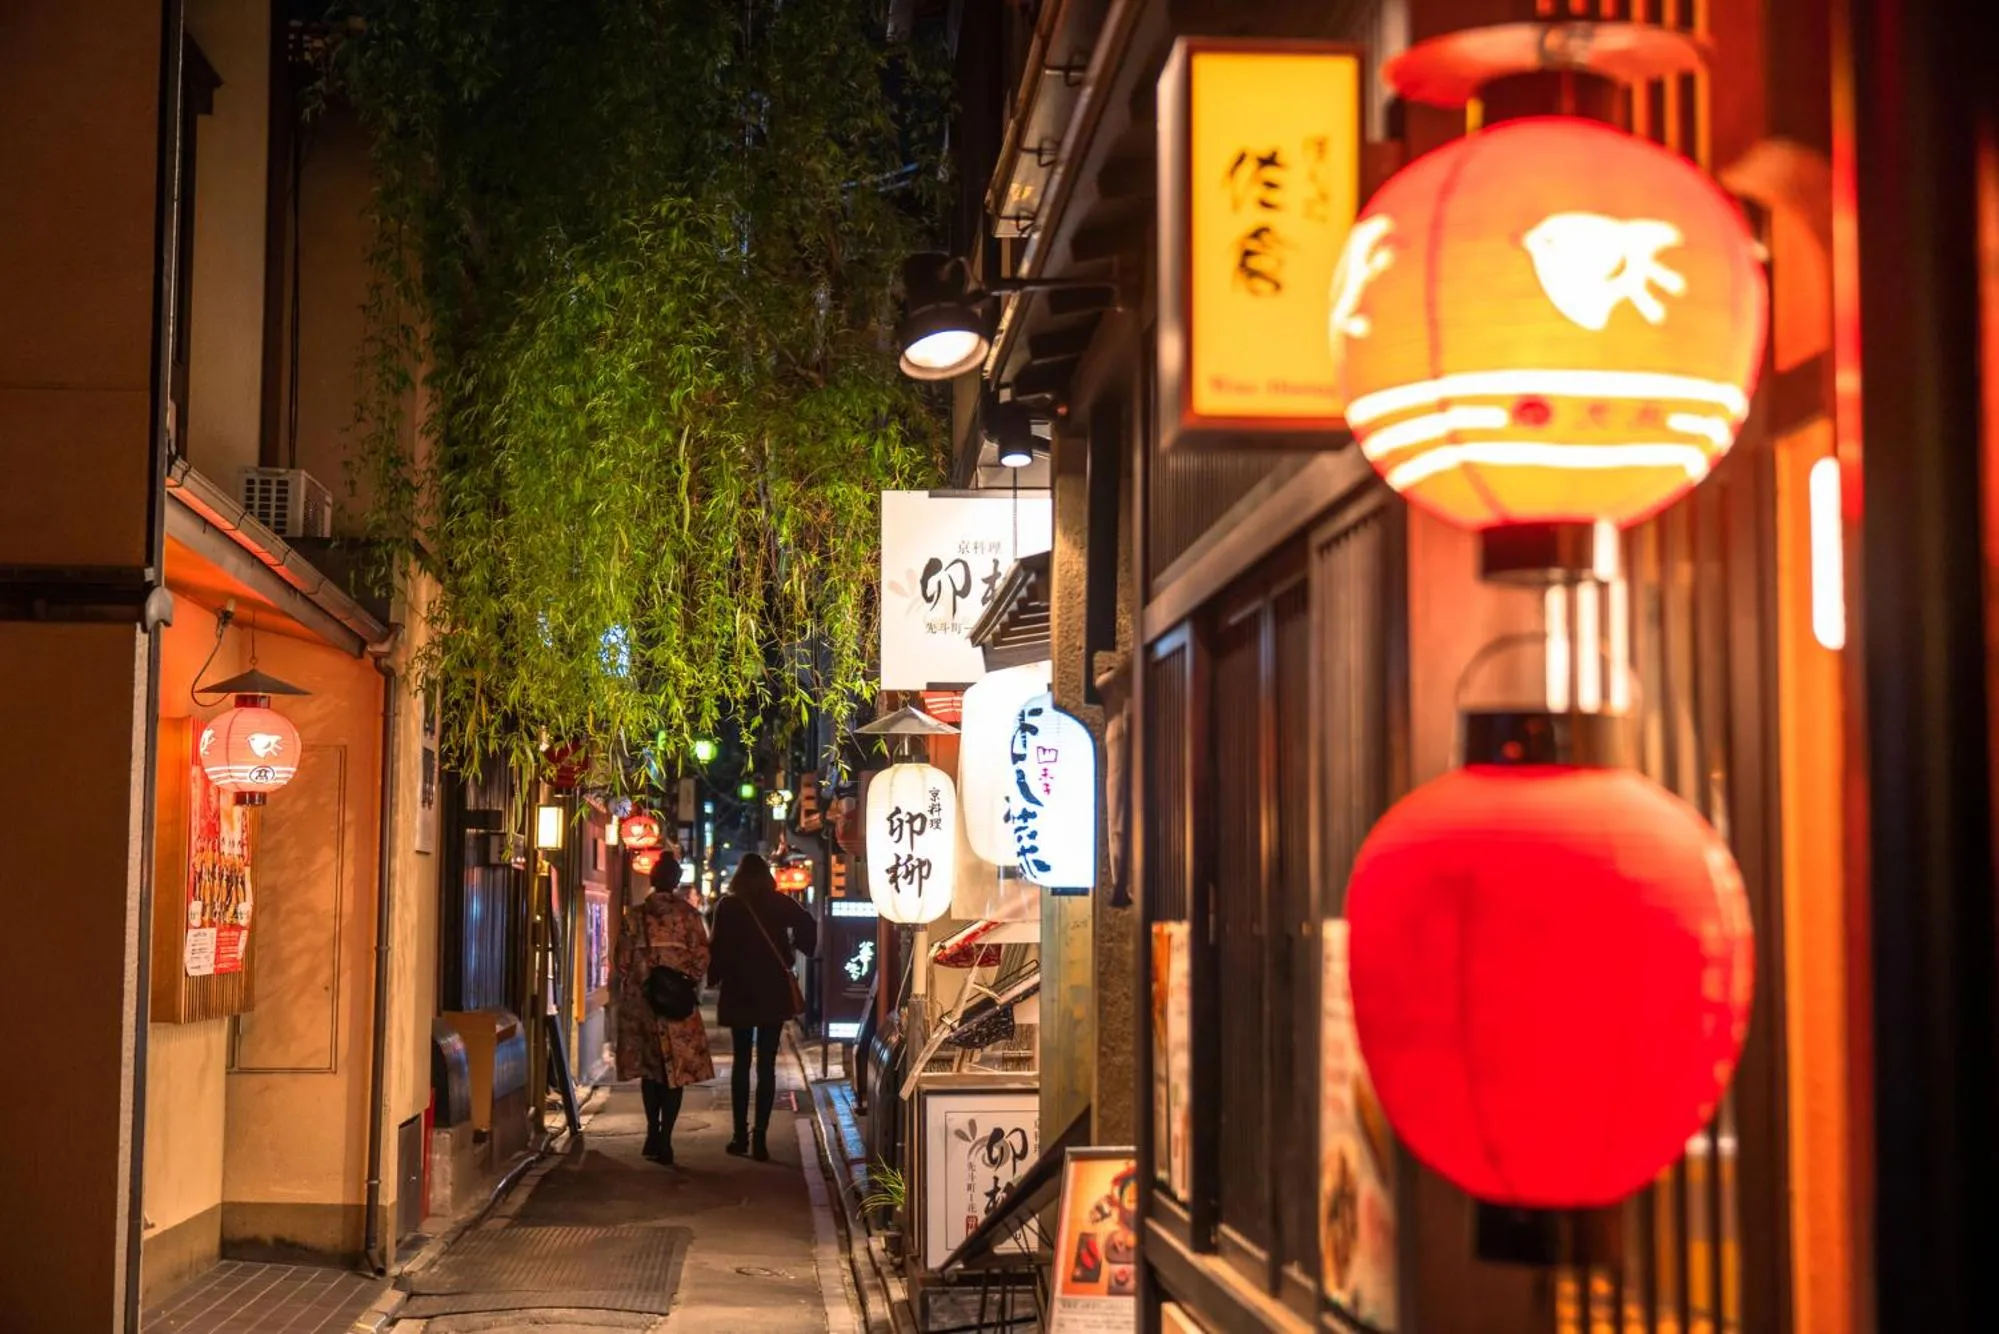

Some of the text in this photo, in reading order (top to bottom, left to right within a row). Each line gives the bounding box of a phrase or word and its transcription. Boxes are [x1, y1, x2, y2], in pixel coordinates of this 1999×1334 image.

[957, 540, 1002, 555] 京料理
[927, 787, 943, 831] 京料理
[884, 805, 932, 899] 卯柳
